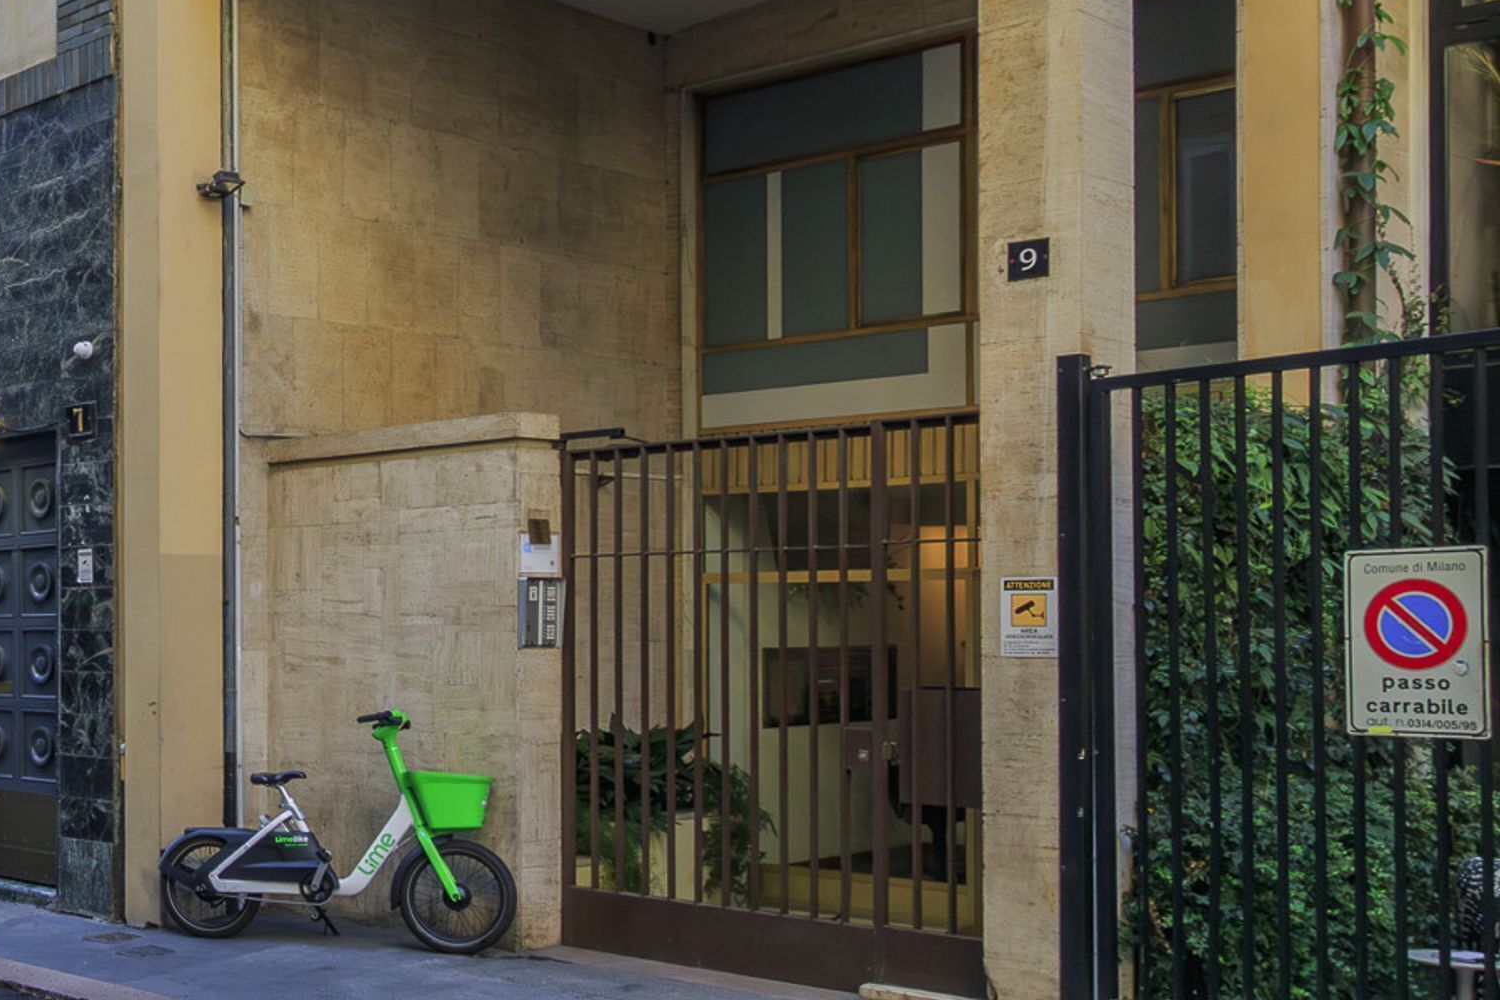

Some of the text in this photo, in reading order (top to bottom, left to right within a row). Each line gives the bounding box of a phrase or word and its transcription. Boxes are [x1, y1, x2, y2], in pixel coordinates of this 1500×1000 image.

[1020, 248, 1037, 271] 9
[1363, 561, 1466, 574] Comune di Milano
[1382, 677, 1450, 692] passo
[1366, 699, 1468, 714] carrabile
[357, 833, 396, 876] Lime
